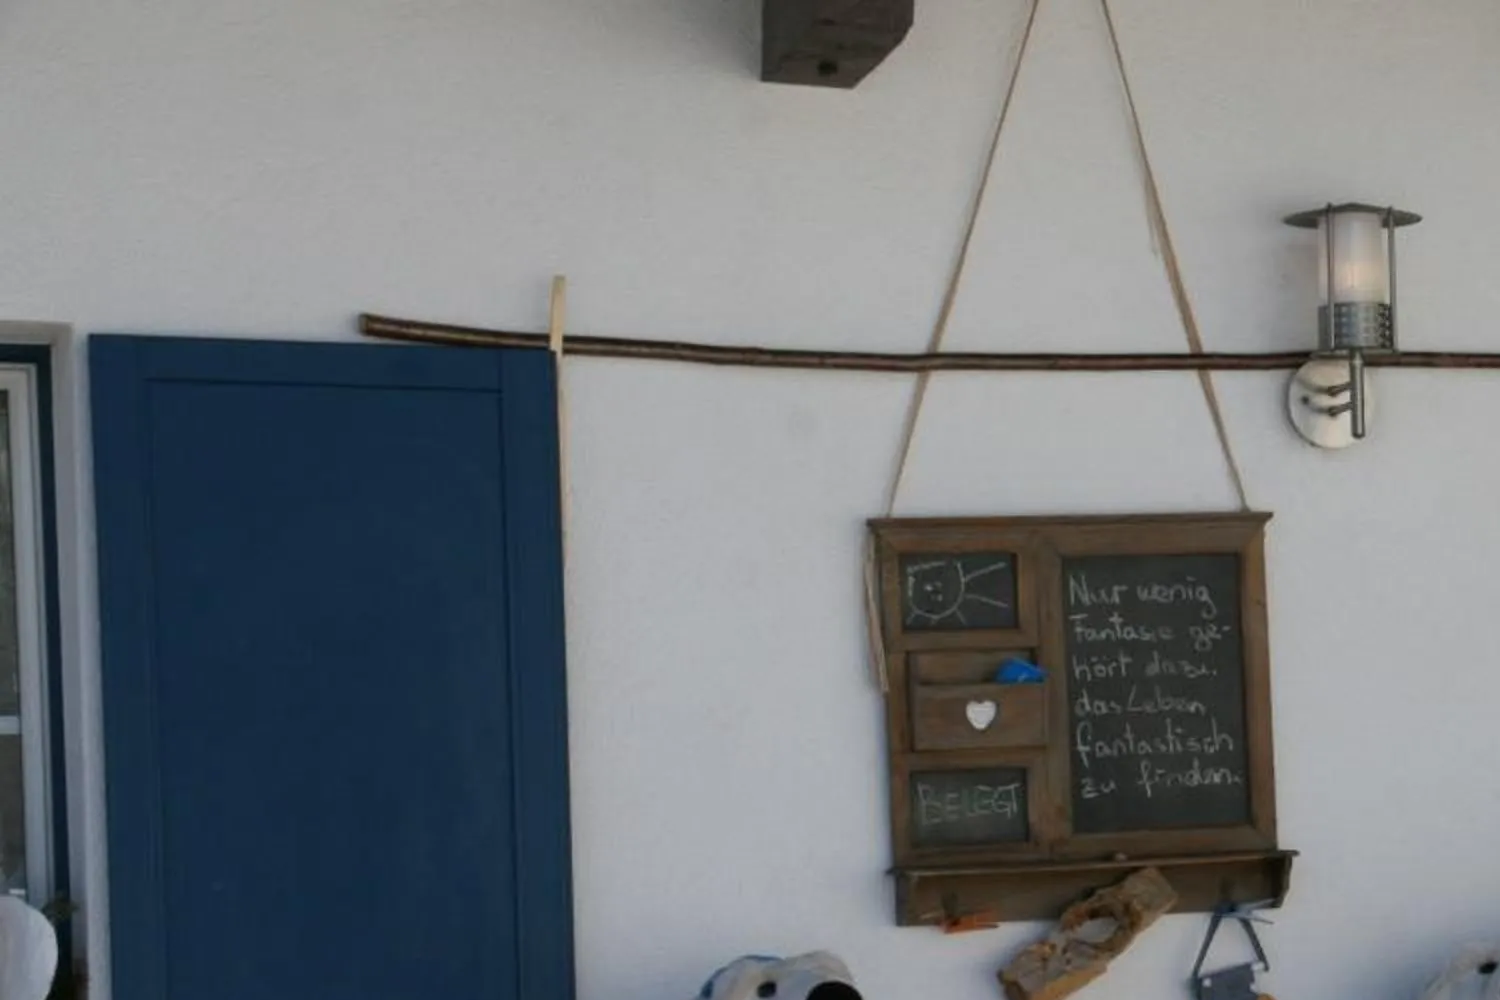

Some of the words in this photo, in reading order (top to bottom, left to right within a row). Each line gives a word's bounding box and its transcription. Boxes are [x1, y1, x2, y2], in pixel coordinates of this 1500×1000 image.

[1068, 574, 1129, 607] Nur
[1136, 576, 1217, 619] wenig
[1072, 649, 1133, 682] hört
